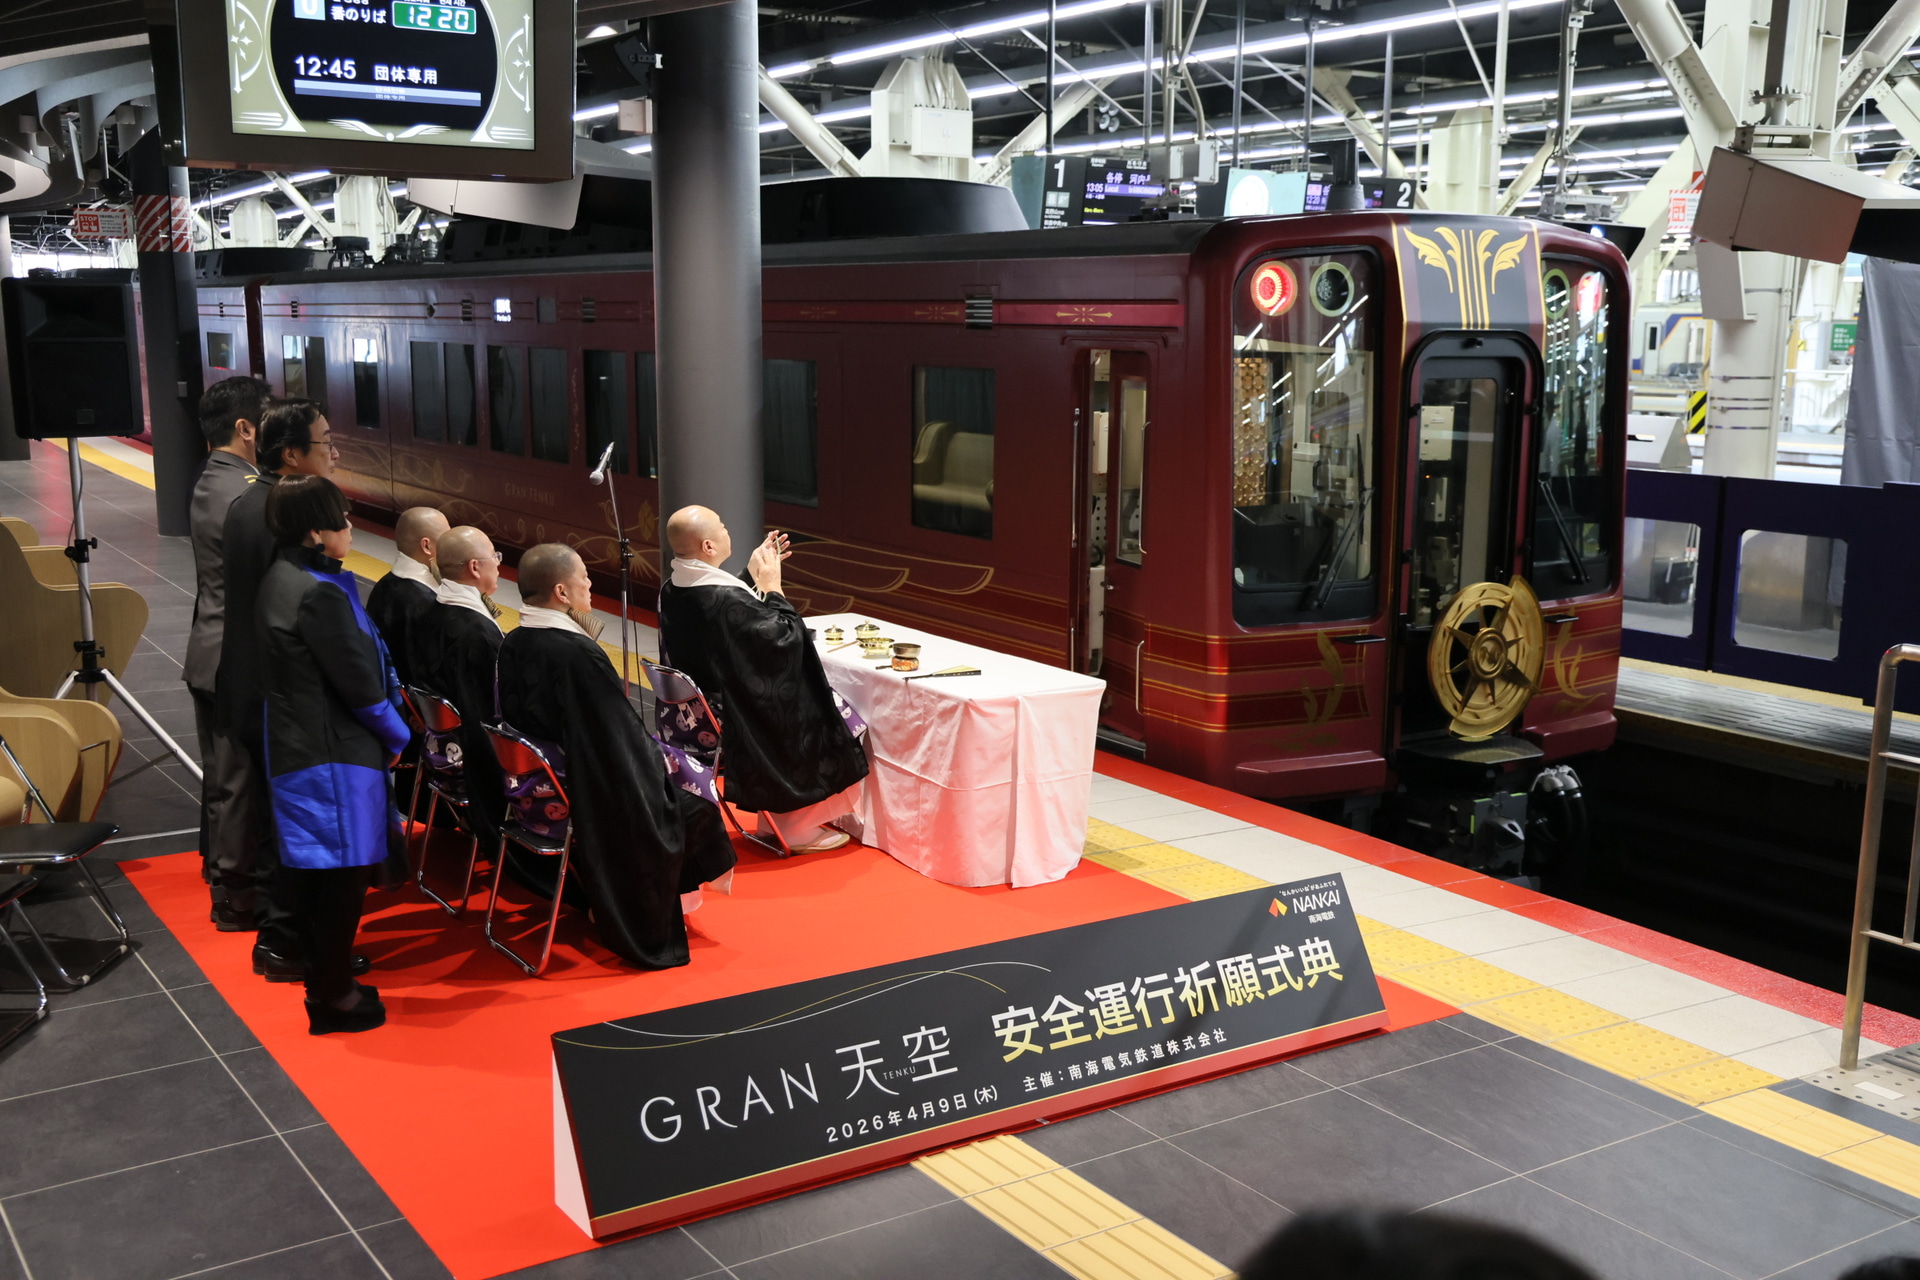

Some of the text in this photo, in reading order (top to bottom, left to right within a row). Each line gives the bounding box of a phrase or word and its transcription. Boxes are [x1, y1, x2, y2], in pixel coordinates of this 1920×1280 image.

[331, 6, 387, 24] 番のりば
[294, 55, 438, 85] 12:45 団体専用
[1054, 159, 1065, 188] 1
[1396, 182, 1412, 207] 2
[1292, 889, 1341, 914] NANKAI
[1308, 911, 1336, 923] 南海電鉄
[640, 936, 1344, 1143] GRAN 天空 安全運行祈願式典
[882, 1066, 917, 1080] TENKU
